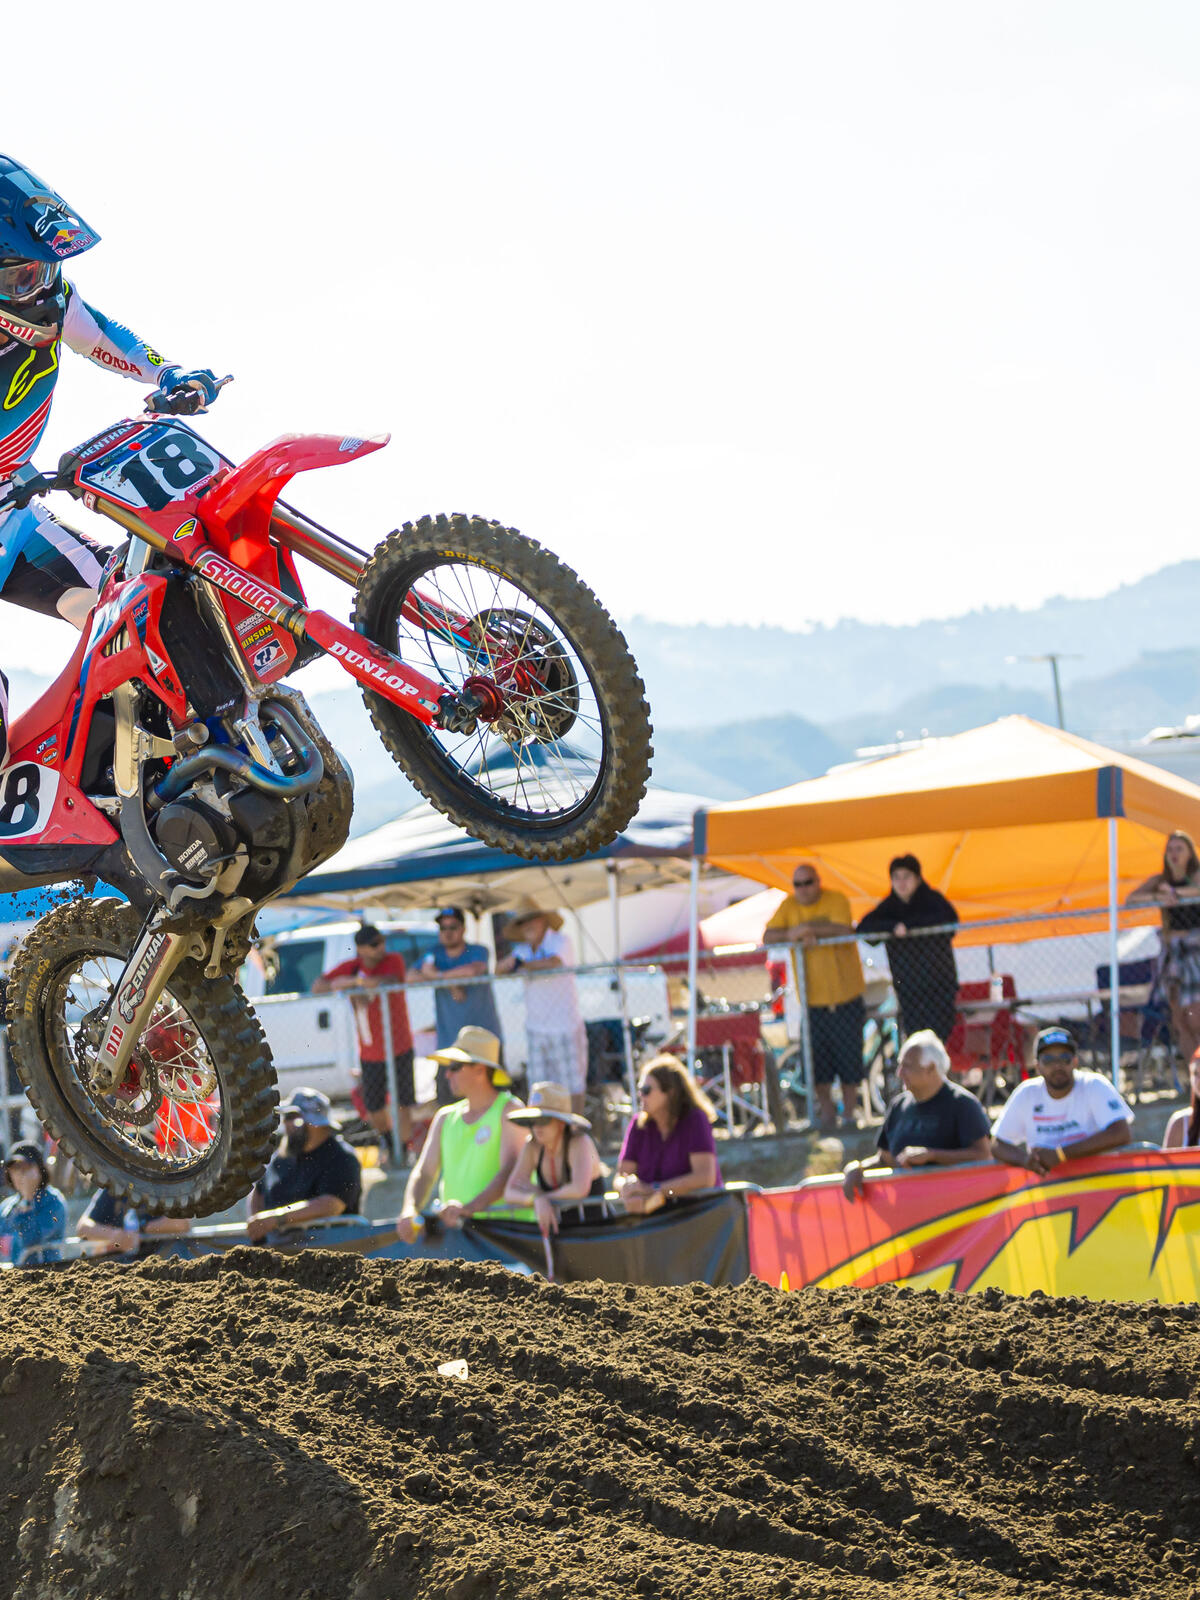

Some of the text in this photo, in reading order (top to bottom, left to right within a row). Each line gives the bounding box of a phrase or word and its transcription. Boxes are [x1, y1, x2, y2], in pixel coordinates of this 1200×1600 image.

[55, 234, 94, 256] Red Bull
[91, 346, 143, 377] HONDA
[121, 433, 214, 512] 18
[442, 550, 513, 580] DUNLOP
[200, 559, 280, 614] SHOWA
[235, 612, 263, 631] WORKS
[327, 641, 420, 697] DUNLOP
[177, 840, 203, 864] HONDA
